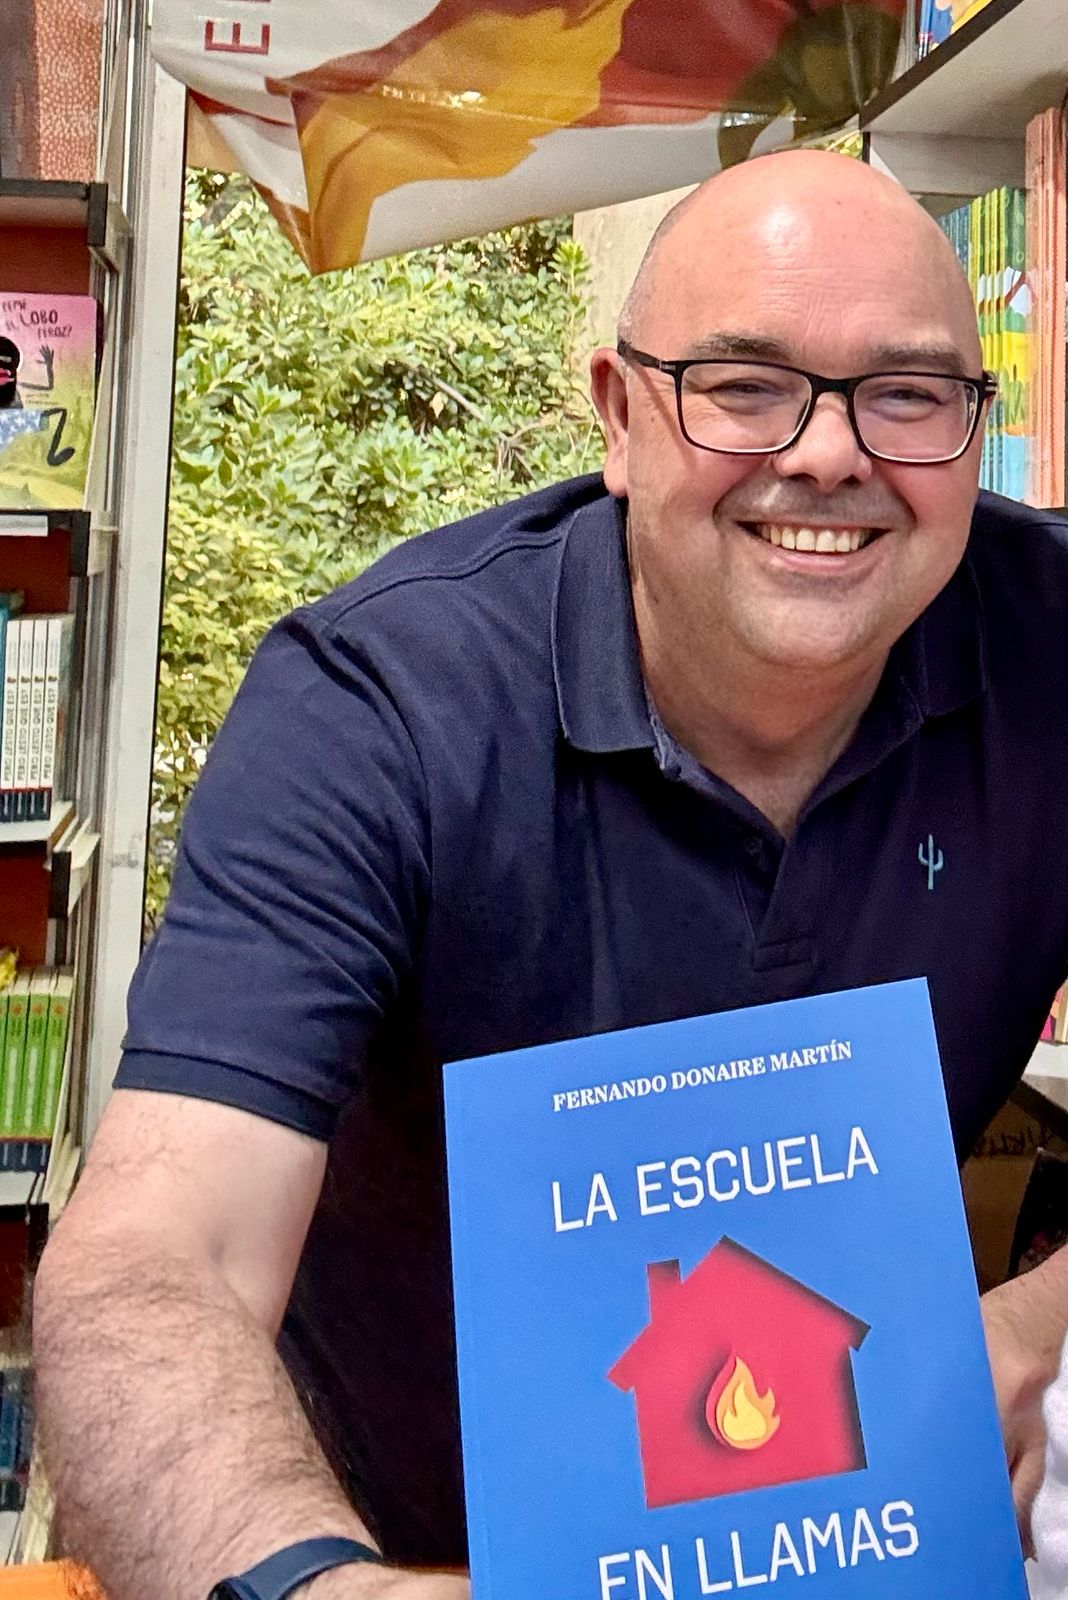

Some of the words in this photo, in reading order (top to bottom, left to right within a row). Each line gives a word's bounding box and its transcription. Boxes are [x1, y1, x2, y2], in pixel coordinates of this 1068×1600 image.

[18, 308, 59, 328] LOBO
[553, 1075, 667, 1112] FERNANDO
[671, 1057, 766, 1090] DONAIRE
[769, 1039, 852, 1072] MARTÍN
[552, 1173, 618, 1233] LA
[636, 1126, 879, 1216] ESCUELA
[598, 1544, 674, 1600] EN
[695, 1500, 919, 1594] LLAMAS
